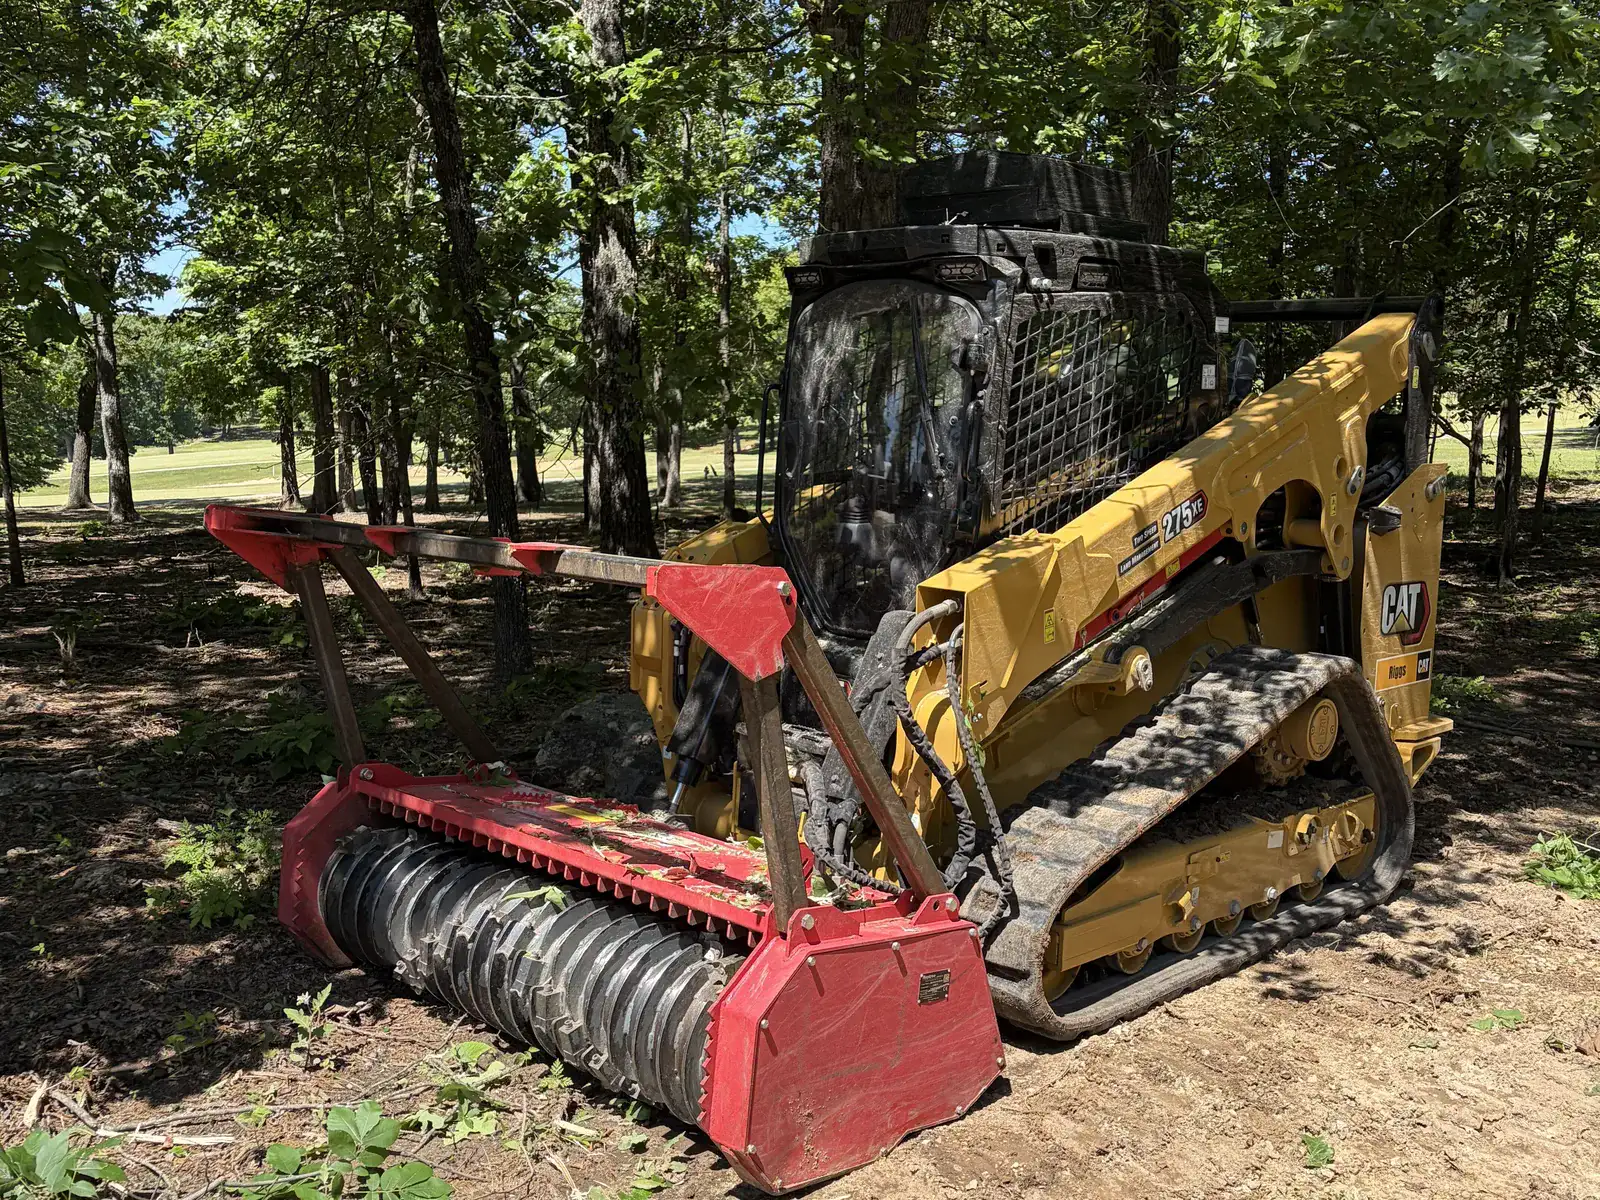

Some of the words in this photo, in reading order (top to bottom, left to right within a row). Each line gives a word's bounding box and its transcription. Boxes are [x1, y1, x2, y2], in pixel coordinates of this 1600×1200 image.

[1381, 583, 1421, 634] CAT
[1388, 665, 1407, 680] Riggs
[1418, 658, 1430, 673] CAT
